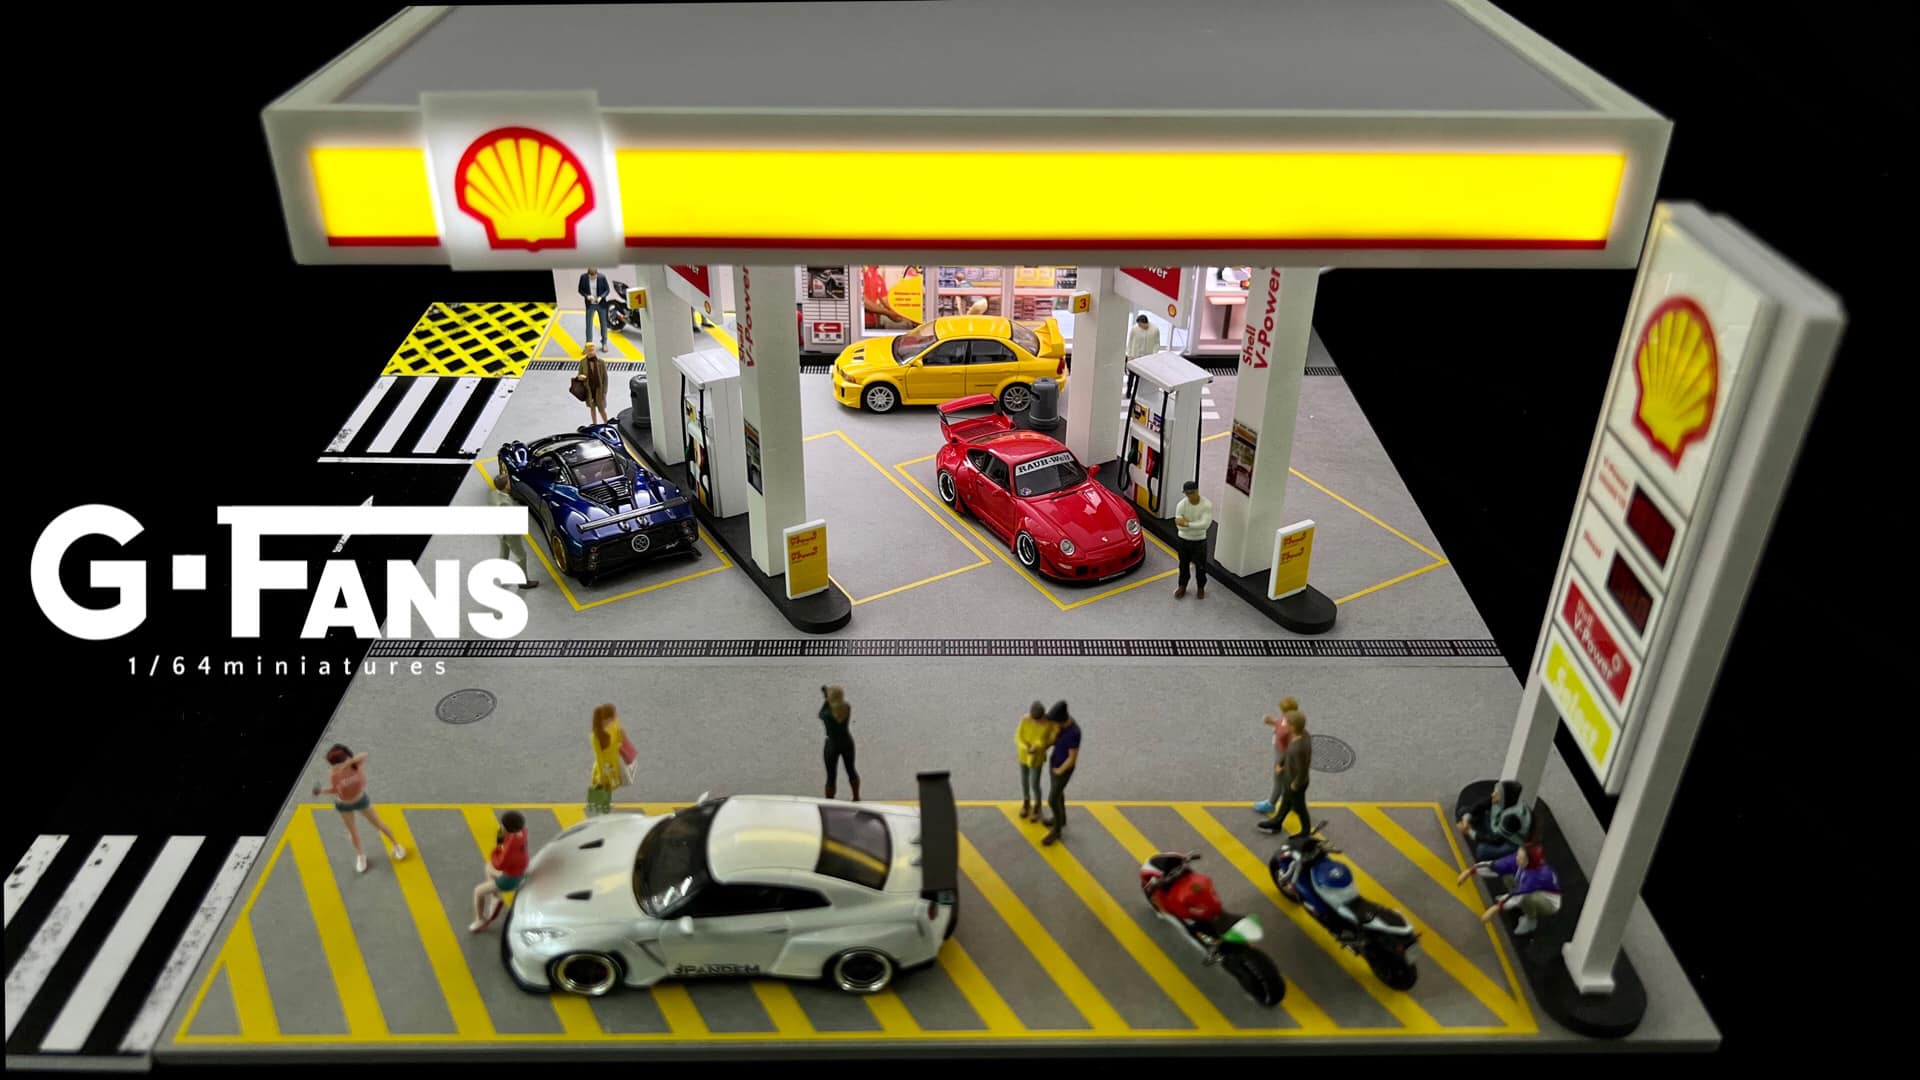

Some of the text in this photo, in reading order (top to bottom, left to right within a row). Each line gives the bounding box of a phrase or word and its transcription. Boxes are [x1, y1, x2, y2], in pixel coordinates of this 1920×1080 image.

[634, 293, 642, 305] 1
[1079, 298, 1087, 309] 3
[1254, 267, 1281, 369] V-Power
[1242, 324, 1256, 366] Shell
[1574, 612, 1614, 682] V-Power
